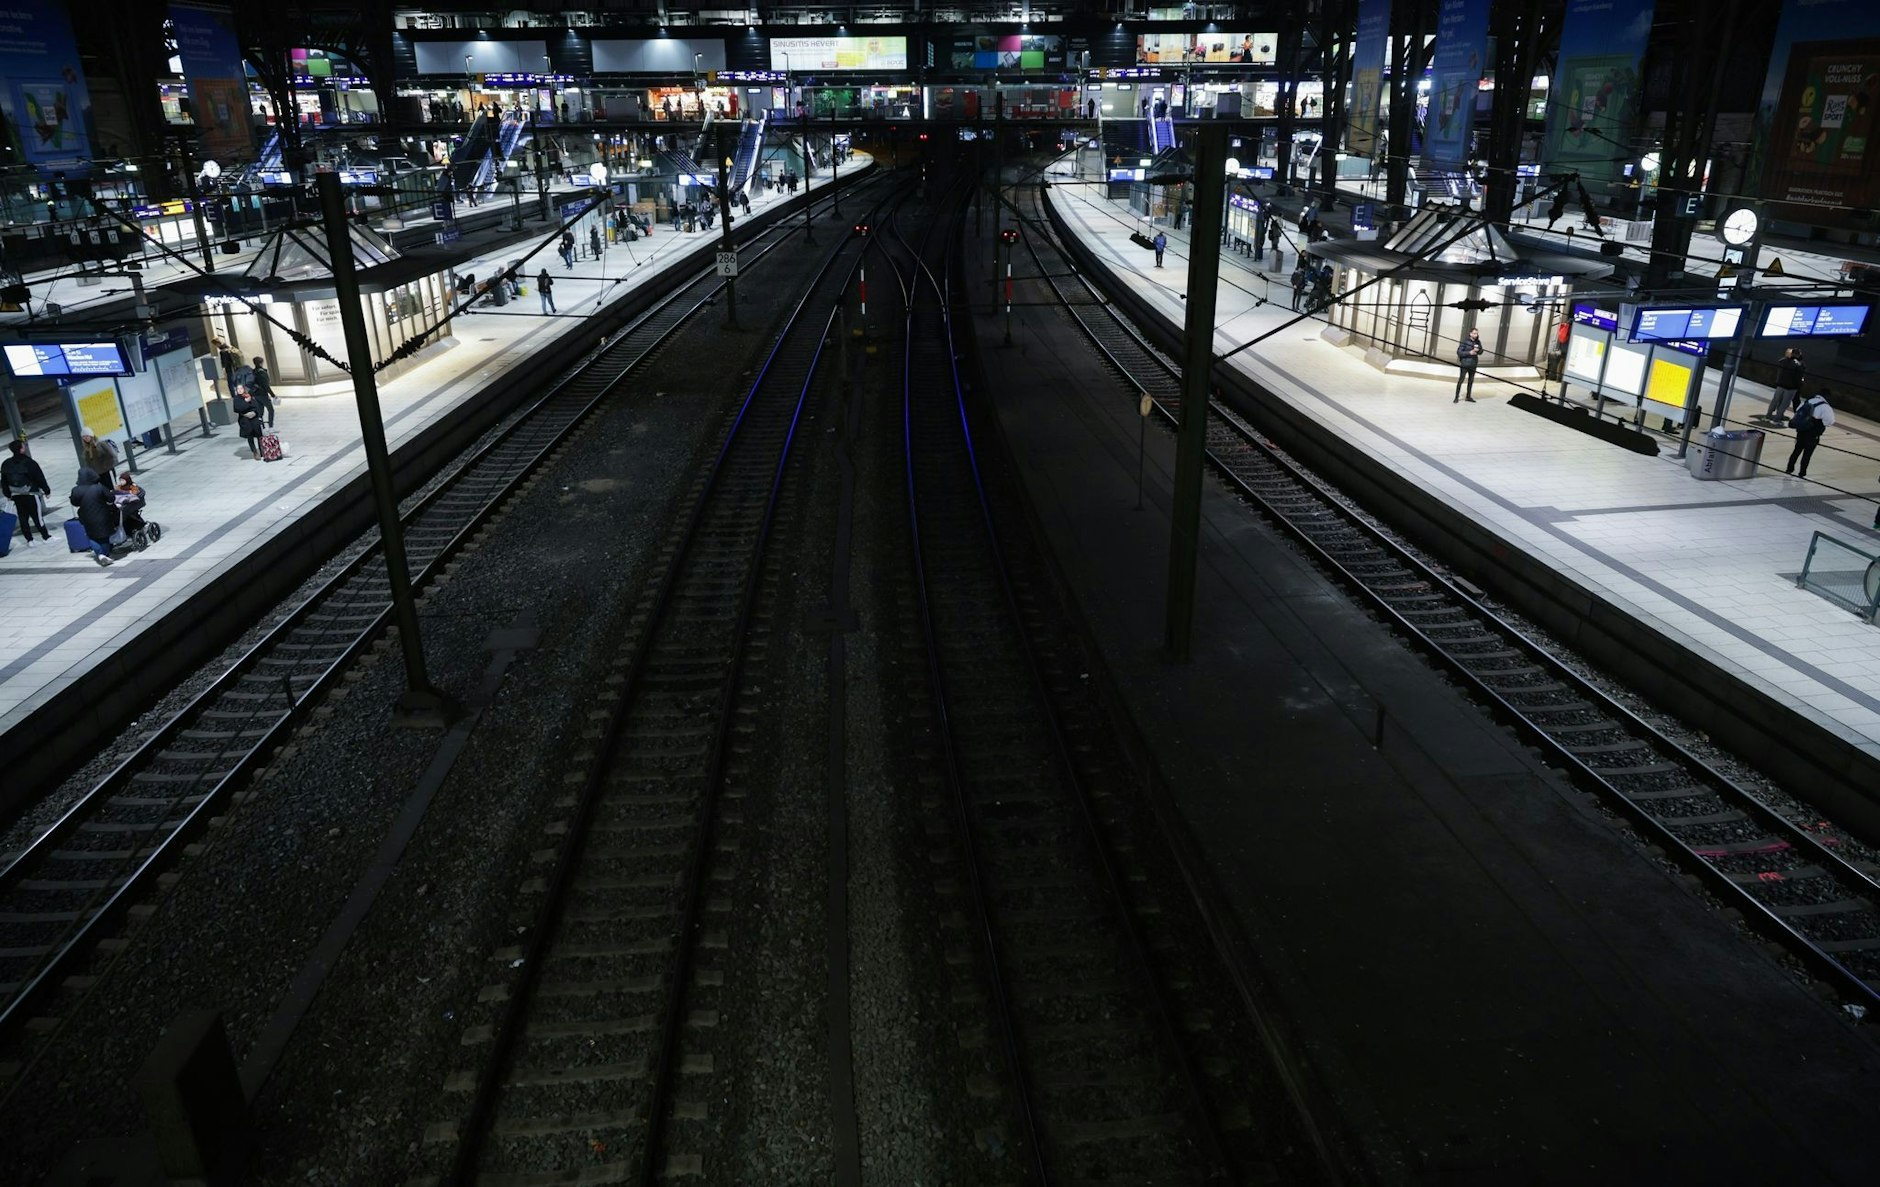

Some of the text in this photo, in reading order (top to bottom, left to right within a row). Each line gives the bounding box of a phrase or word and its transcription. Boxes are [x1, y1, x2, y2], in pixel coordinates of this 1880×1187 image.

[1827, 63, 1864, 74] CRUNCHY
[434, 203, 445, 218] E
[1685, 197, 1698, 213] E
[1355, 205, 1364, 221] E
[717, 253, 736, 264] 286
[724, 264, 731, 274] 6
[1498, 276, 1550, 286] ServiceStore
[204, 295, 260, 304] Serviceore
[1704, 448, 1716, 473] Abfal
